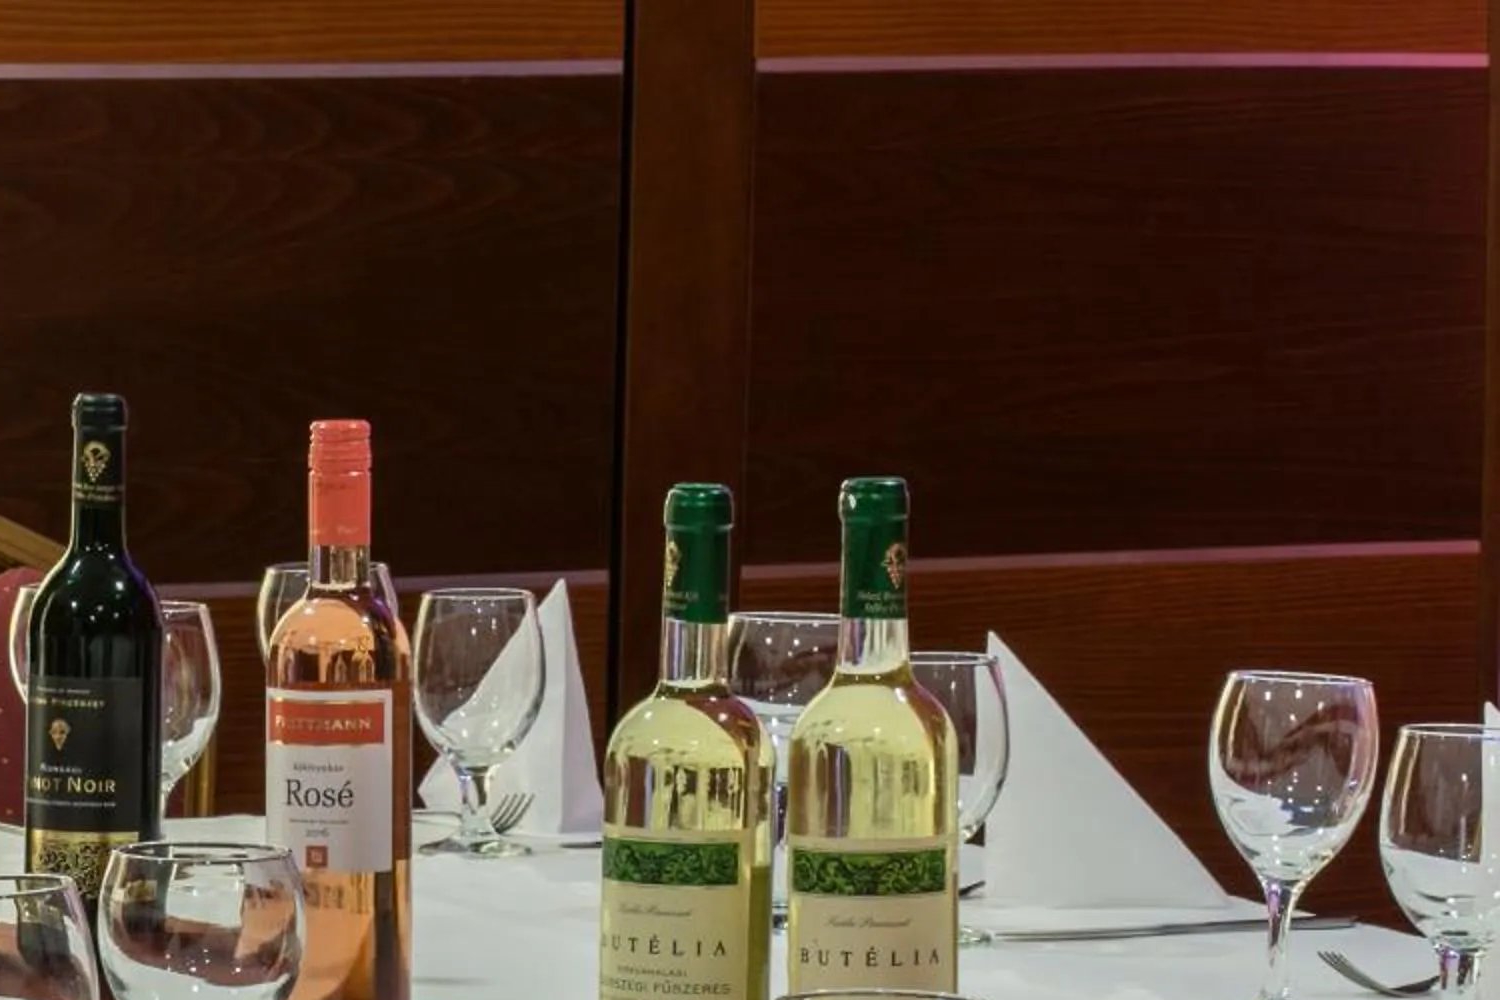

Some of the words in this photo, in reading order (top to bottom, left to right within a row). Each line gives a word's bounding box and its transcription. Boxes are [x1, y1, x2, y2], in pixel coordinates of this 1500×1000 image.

[67, 776, 116, 793] NOIR
[286, 779, 354, 808] Rosé
[800, 946, 941, 968] BUTÉLIA
